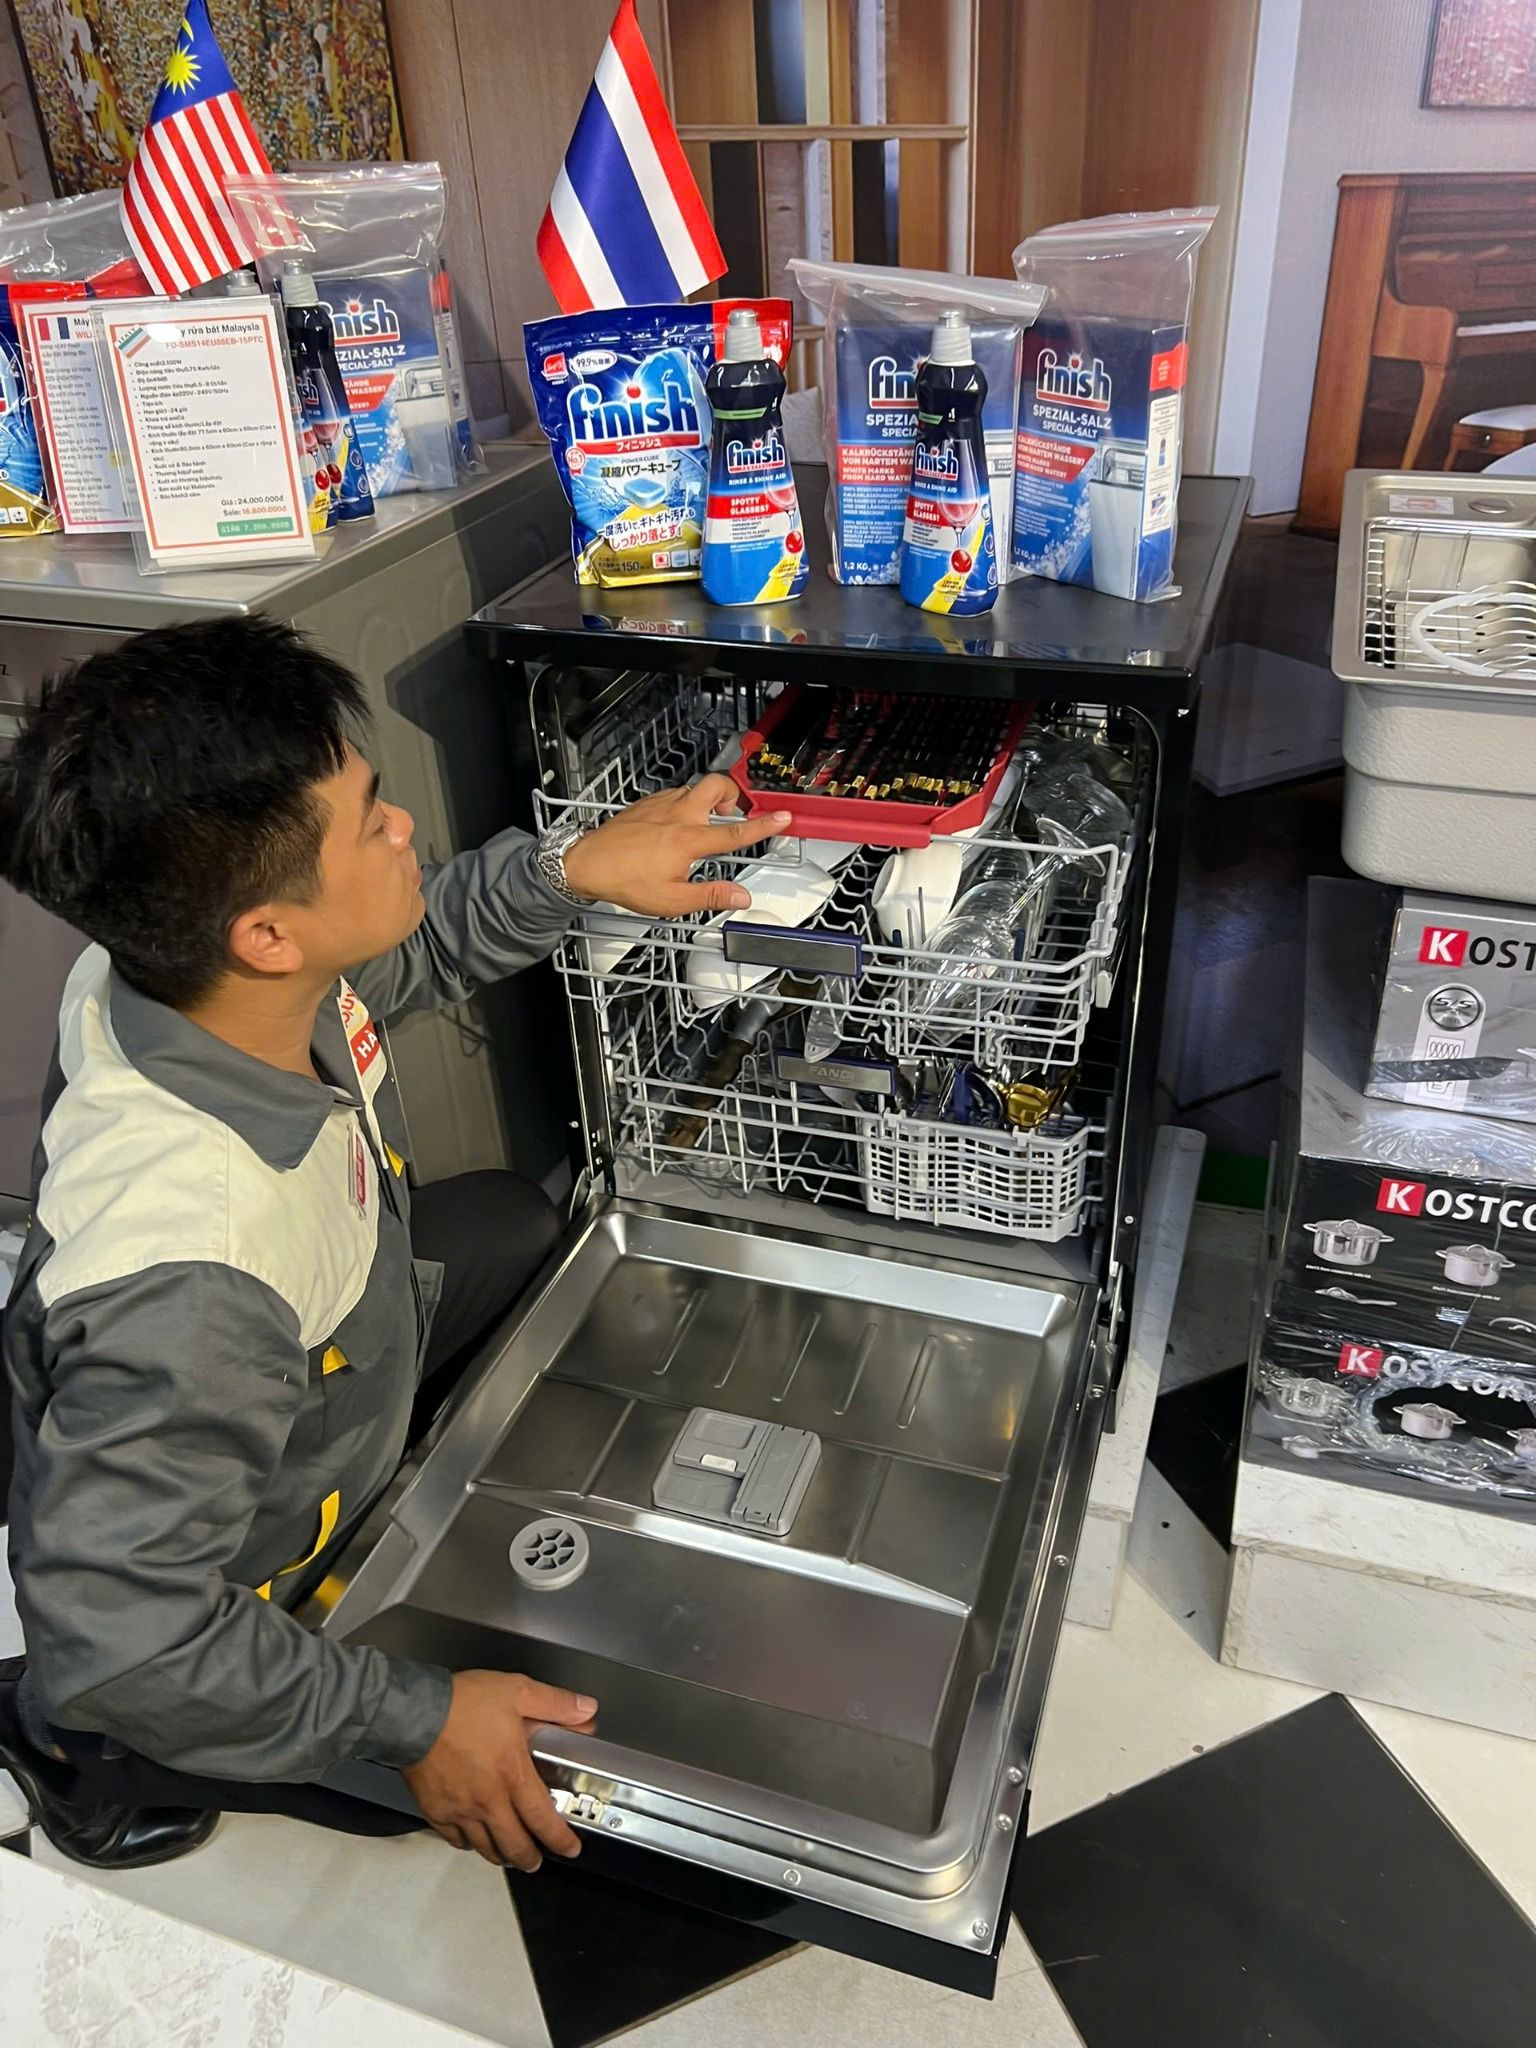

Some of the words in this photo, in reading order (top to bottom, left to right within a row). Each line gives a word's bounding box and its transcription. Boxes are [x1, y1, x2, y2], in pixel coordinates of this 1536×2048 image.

[1037, 349, 1110, 403] finish
[569, 384, 699, 441] finish
[866, 414, 918, 426] SPEZIA
[1033, 404, 1112, 430] SPEZIAL-SALZ
[882, 428, 917, 437] SPECIA
[1043, 421, 1098, 438] SPECIAL-SALT
[616, 438, 662, 453] フィニッシュ
[727, 438, 785, 467] finish
[842, 447, 914, 457] KALKRÜCKSTÄN
[842, 457, 861, 465] VON
[862, 457, 896, 466] HARTEM
[916, 443, 958, 475] finish
[731, 497, 760, 506] SPOTTY
[730, 505, 769, 515] GLASSES?
[622, 562, 640, 571] 150
[1424, 930, 1536, 971] KOST
[1384, 1181, 1536, 1233] KOSTCO
